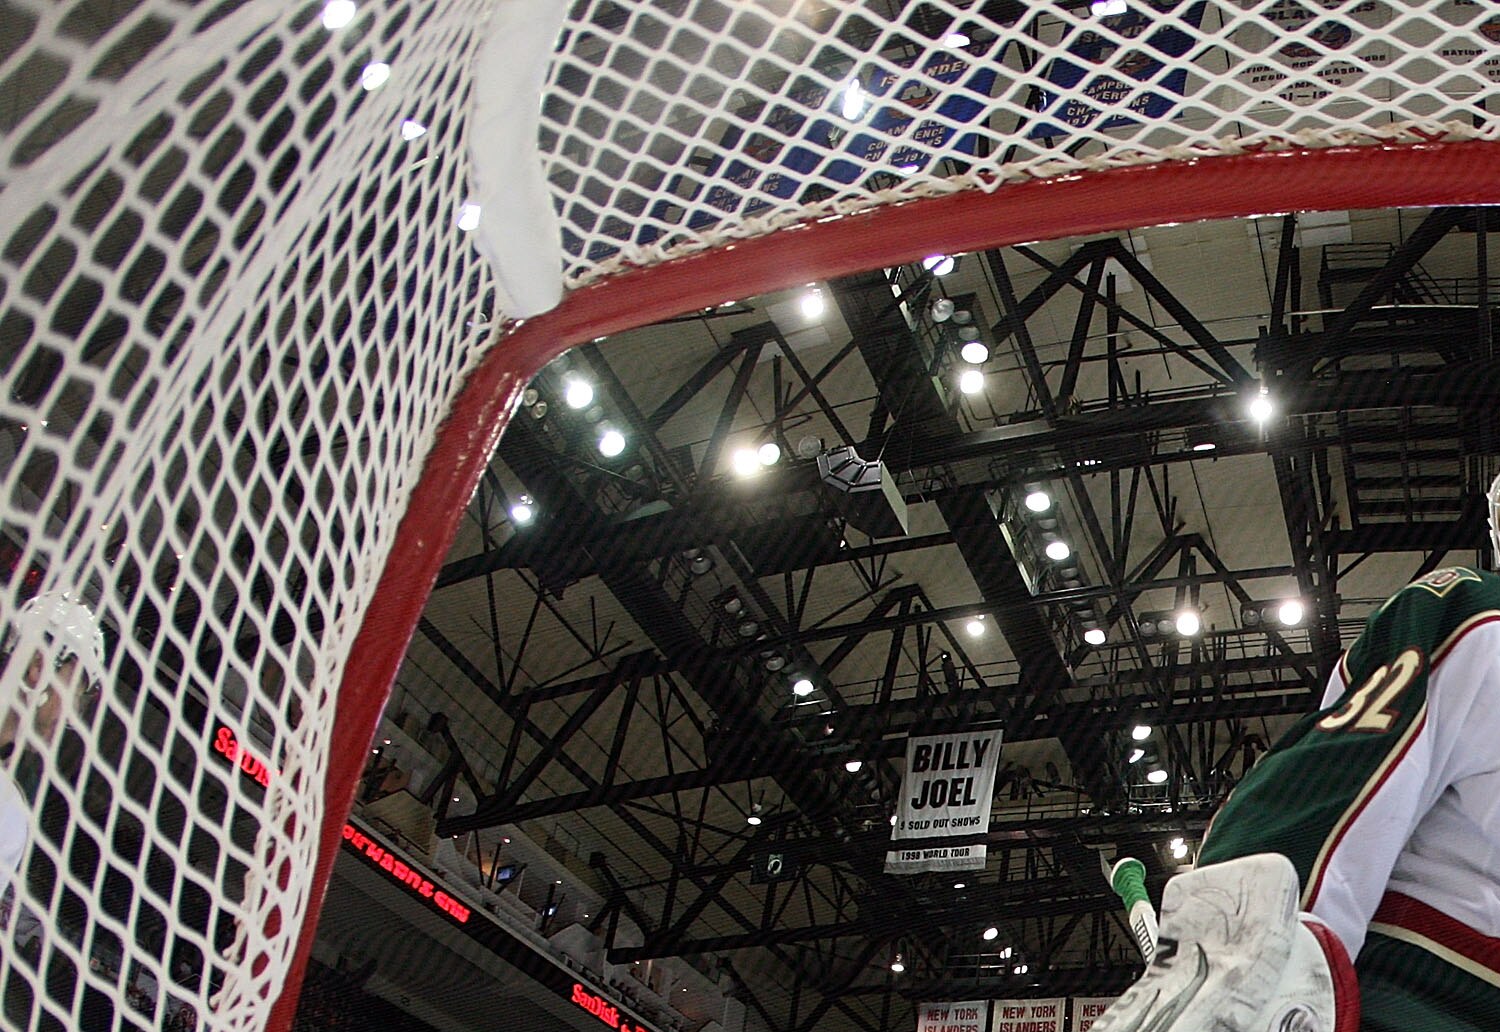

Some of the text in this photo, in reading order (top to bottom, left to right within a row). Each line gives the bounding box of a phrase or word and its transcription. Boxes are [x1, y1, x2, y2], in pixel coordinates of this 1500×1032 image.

[1316, 646, 1424, 733] 32
[912, 739, 991, 773] BILLY
[911, 777, 976, 810] JOEL
[908, 820, 930, 831] SOLD
[933, 818, 949, 828] OUT
[951, 815, 981, 828] SHOWS
[923, 849, 948, 859] WORLD
[950, 847, 970, 857] TOUR
[572, 983, 620, 1029] SanDisk
[927, 1007, 978, 1021] NEW YORK
[1002, 1006, 1056, 1019] NEW YORK
